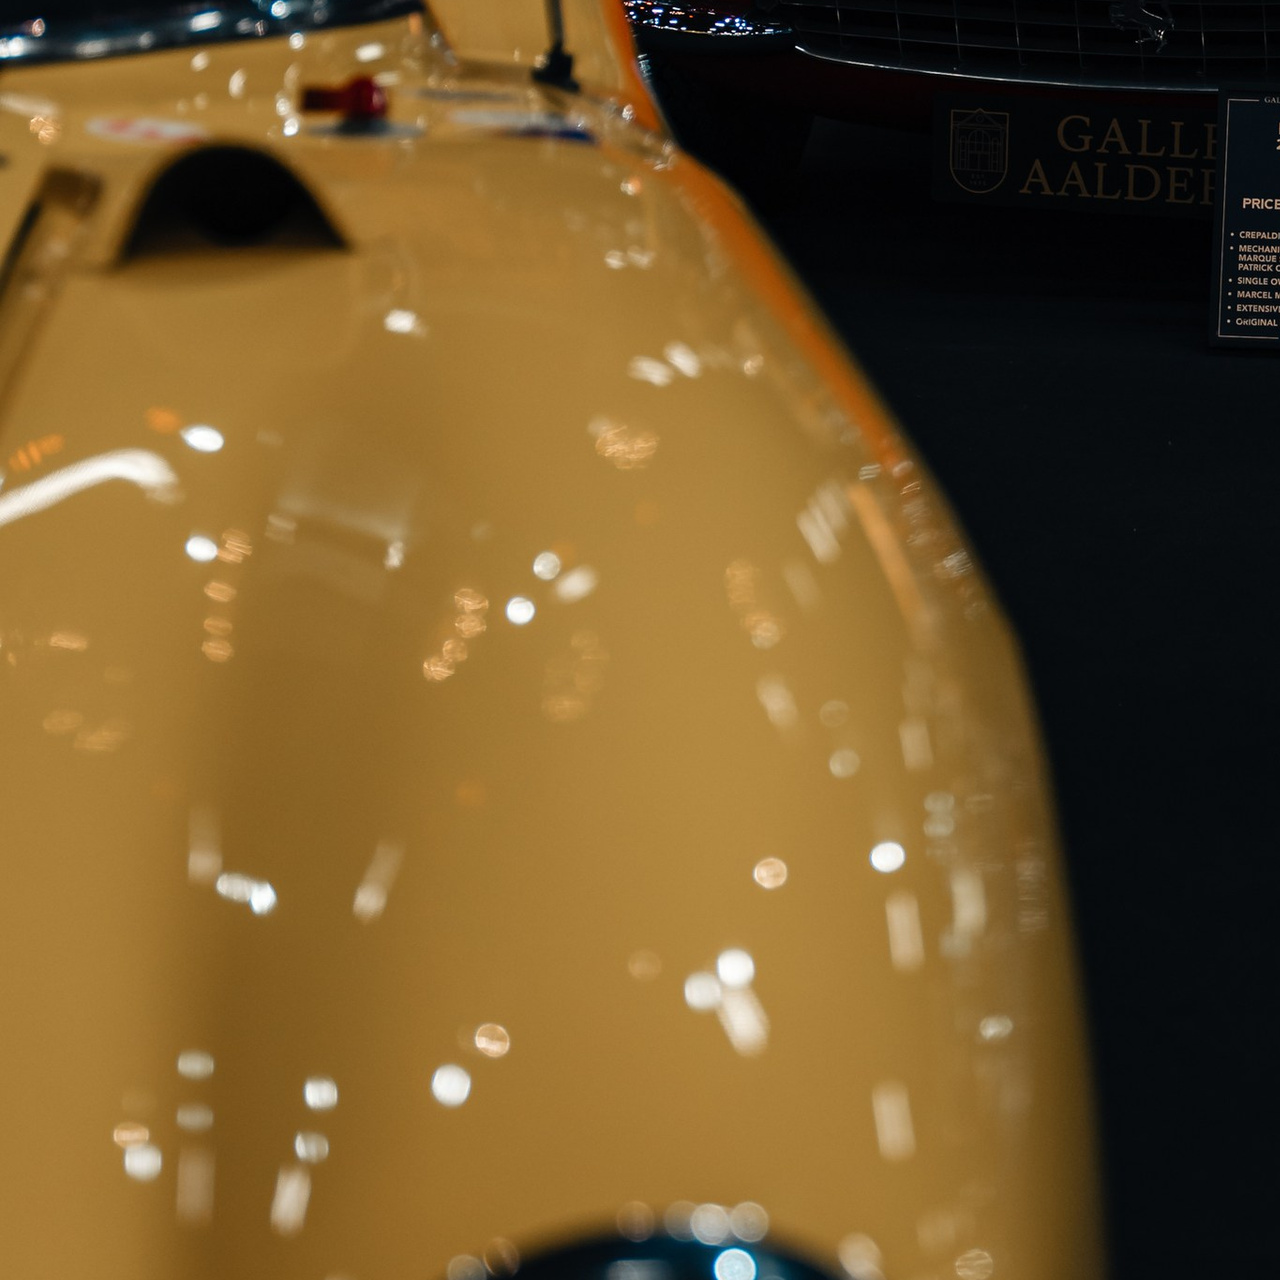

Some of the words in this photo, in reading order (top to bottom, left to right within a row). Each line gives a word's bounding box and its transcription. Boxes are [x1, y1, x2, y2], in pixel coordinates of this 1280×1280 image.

[1240, 231, 1280, 239] CREPALDI
[1239, 254, 1277, 264] MARQUE
[1238, 263, 1273, 272] PATRICK
[1238, 277, 1268, 285] SINGLE
[1237, 291, 1272, 299] MARCEL
[1236, 318, 1278, 326] ORIGINAL
